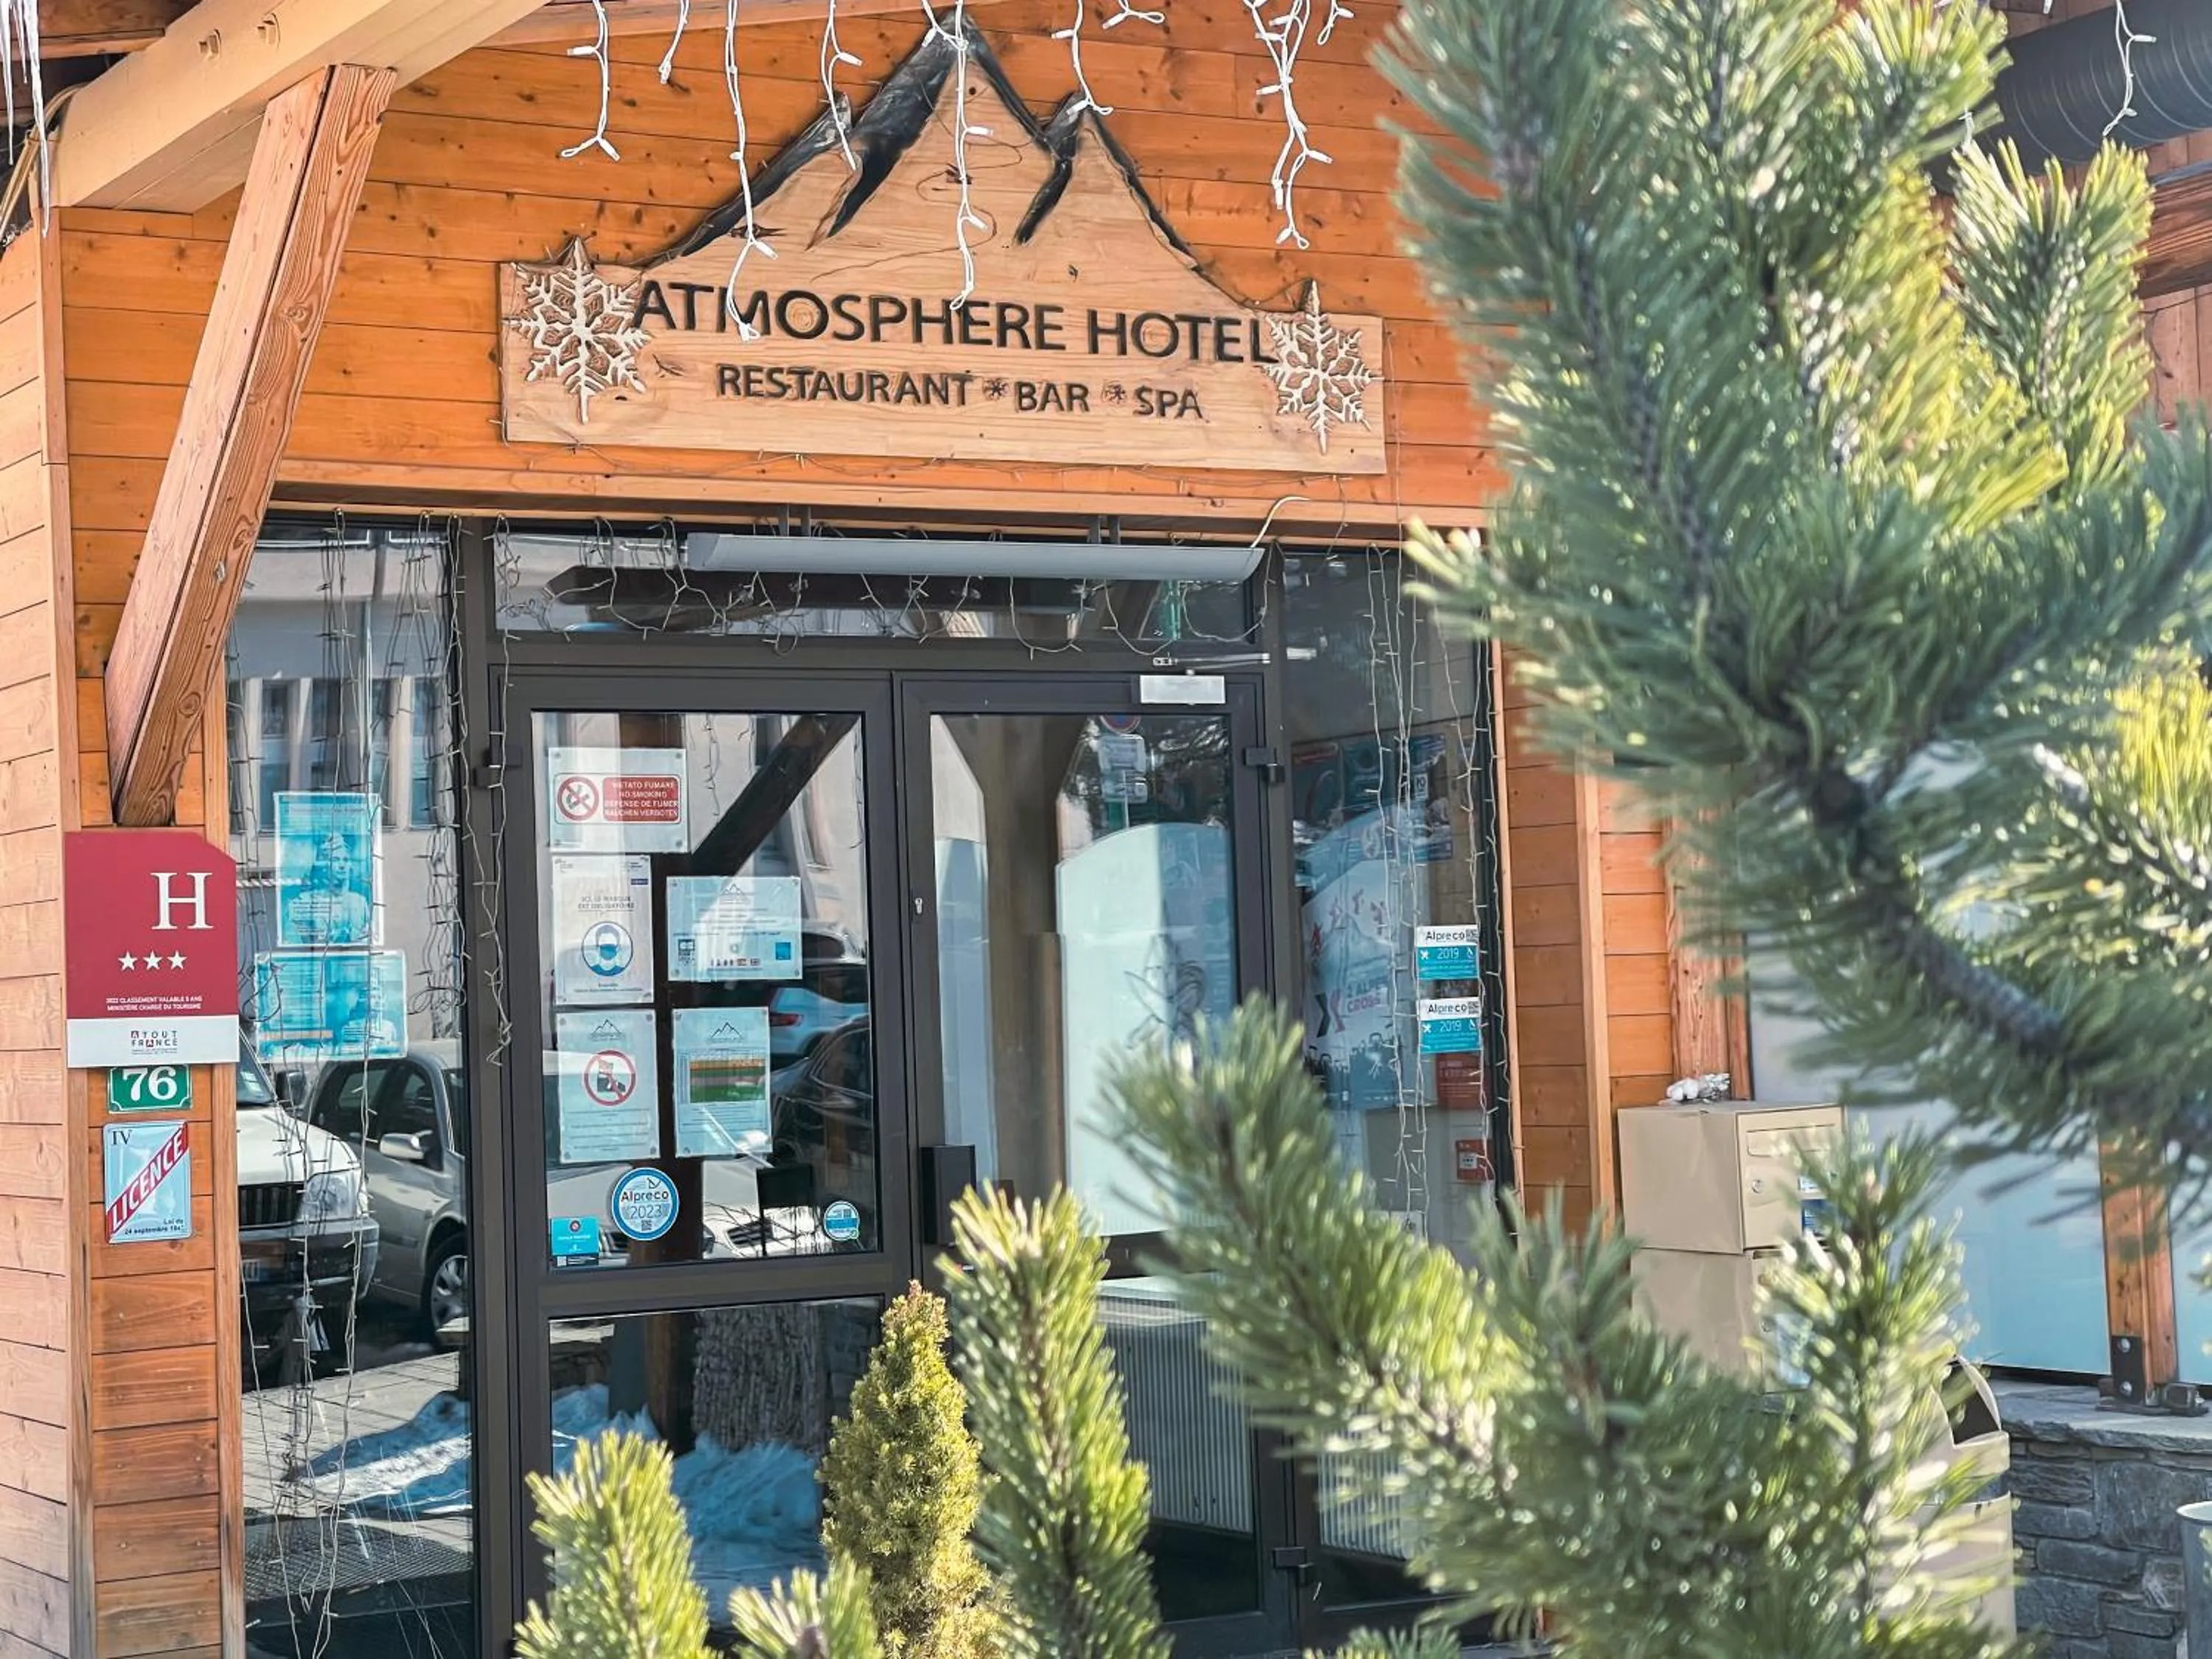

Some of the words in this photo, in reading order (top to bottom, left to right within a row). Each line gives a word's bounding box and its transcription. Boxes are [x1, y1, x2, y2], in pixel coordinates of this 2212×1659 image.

[632, 279, 1066, 349] ATMOSPHERE
[1087, 308, 1280, 364] HOTEL
[716, 364, 973, 406] RESTAURANT
[1015, 380, 1090, 413] BAR
[1133, 385, 1204, 420] SPA
[150, 872, 213, 930] H
[1425, 931, 1466, 942] Alpreco
[1437, 947, 1460, 959] 2019
[1427, 1003, 1467, 1015] Alpreco
[1439, 1020, 1462, 1032] 2019
[131, 1030, 178, 1039] ATOUT
[131, 1038, 178, 1047] FRANCE
[122, 1066, 178, 1101] 76
[111, 1129, 132, 1146] IV
[112, 1130, 184, 1230] LICENCE
[621, 1190, 669, 1204] Alpreco
[630, 1206, 663, 1219] 2023
